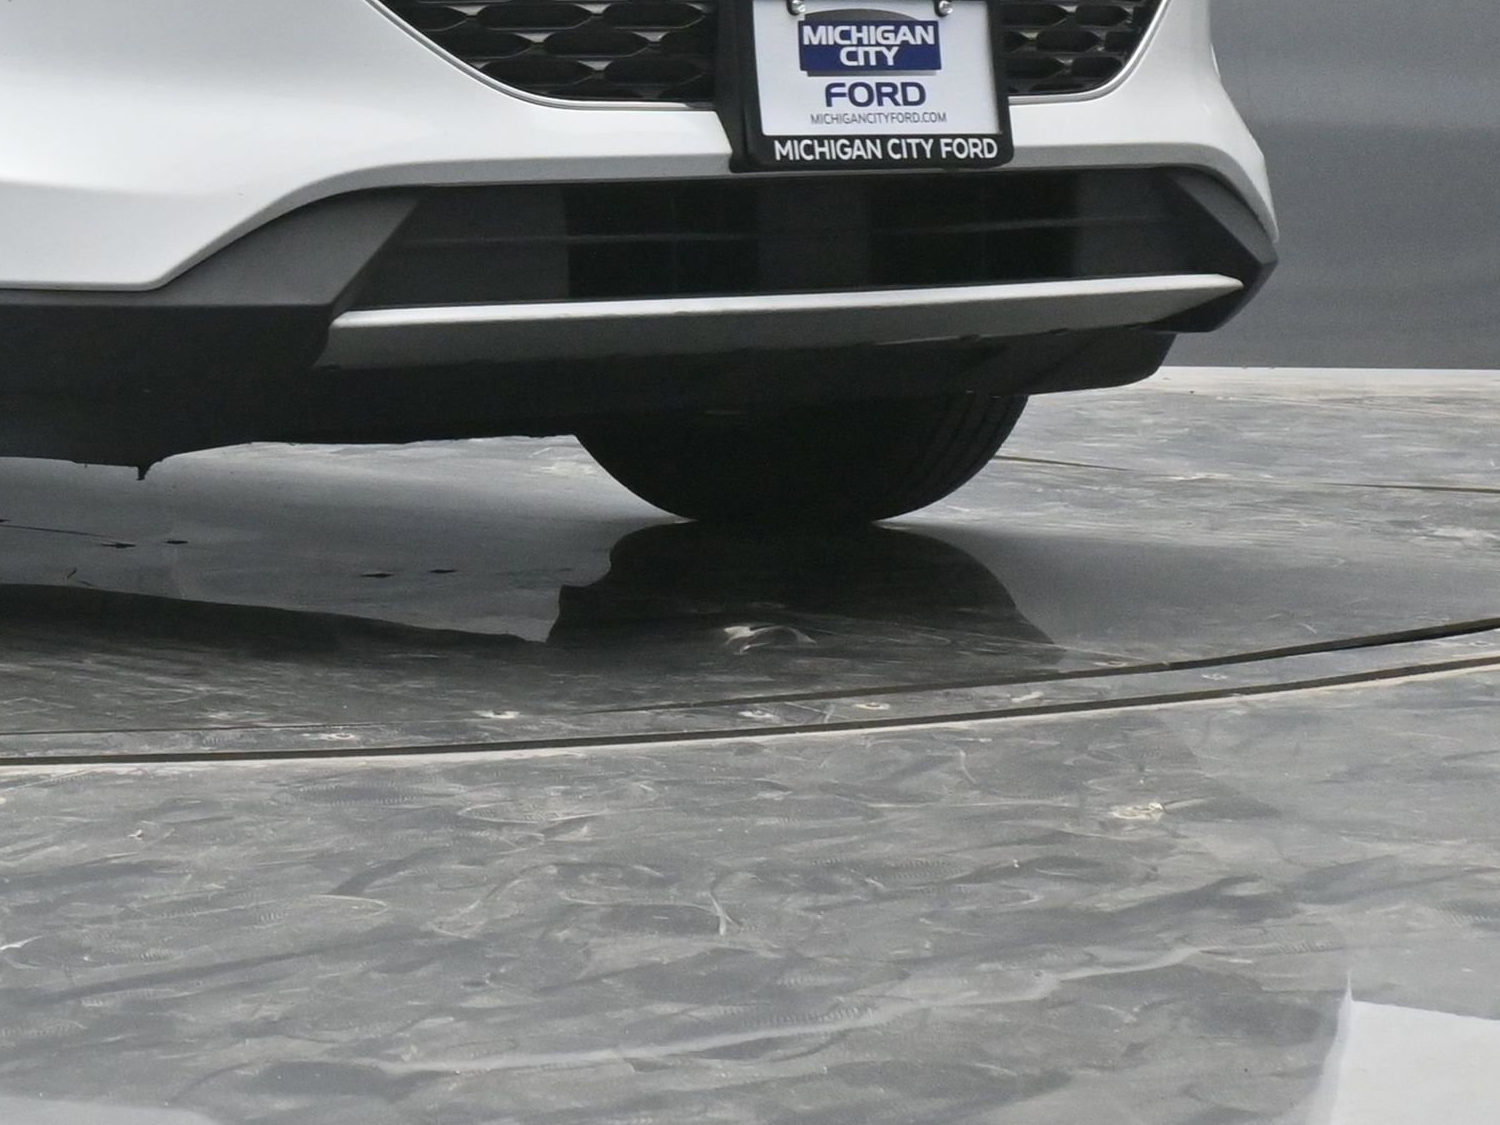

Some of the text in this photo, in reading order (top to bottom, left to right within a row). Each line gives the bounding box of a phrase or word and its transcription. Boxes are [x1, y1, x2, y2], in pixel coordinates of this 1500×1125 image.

[803, 25, 935, 45] MICHIGAN
[839, 46, 899, 66] CITY
[825, 81, 927, 108] FORD
[810, 112, 948, 125] MICHIGANCITYFORD.COM
[774, 138, 998, 161] MICHIGAN CITY FORD
